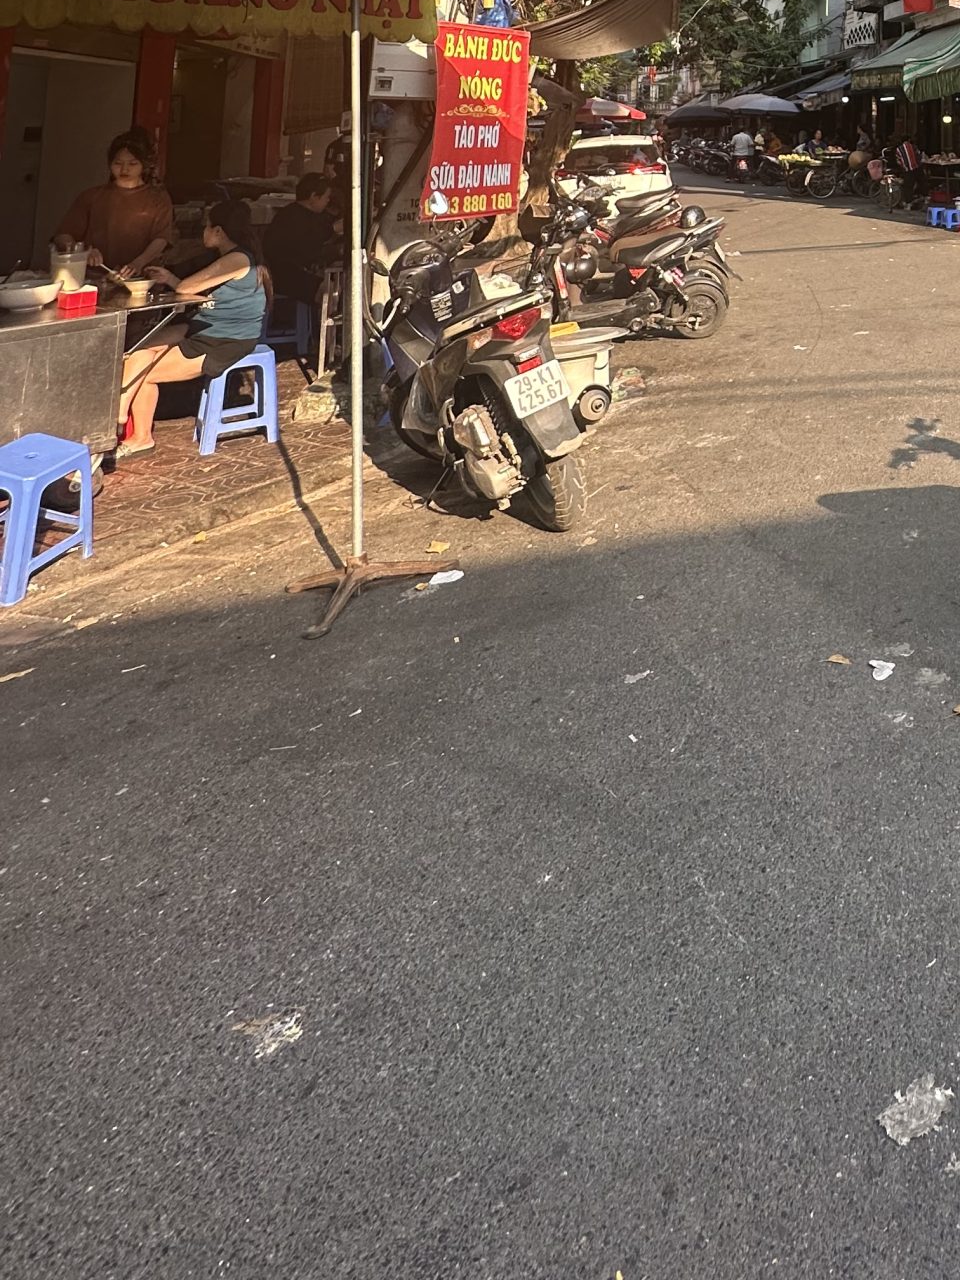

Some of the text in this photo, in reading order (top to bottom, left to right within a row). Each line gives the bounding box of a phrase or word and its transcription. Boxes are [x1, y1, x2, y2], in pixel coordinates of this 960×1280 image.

[443, 28, 522, 64] BÁNH ĐÚC
[458, 69, 503, 101] NÓNG
[454, 120, 501, 149] TÀO PHỚ
[430, 159, 511, 194] SỮA ĐẬU NÀNH
[463, 194, 487, 213] 880
[490, 192, 513, 210] 160
[514, 365, 555, 396] 29-K1
[518, 380, 563, 412] 425.67
